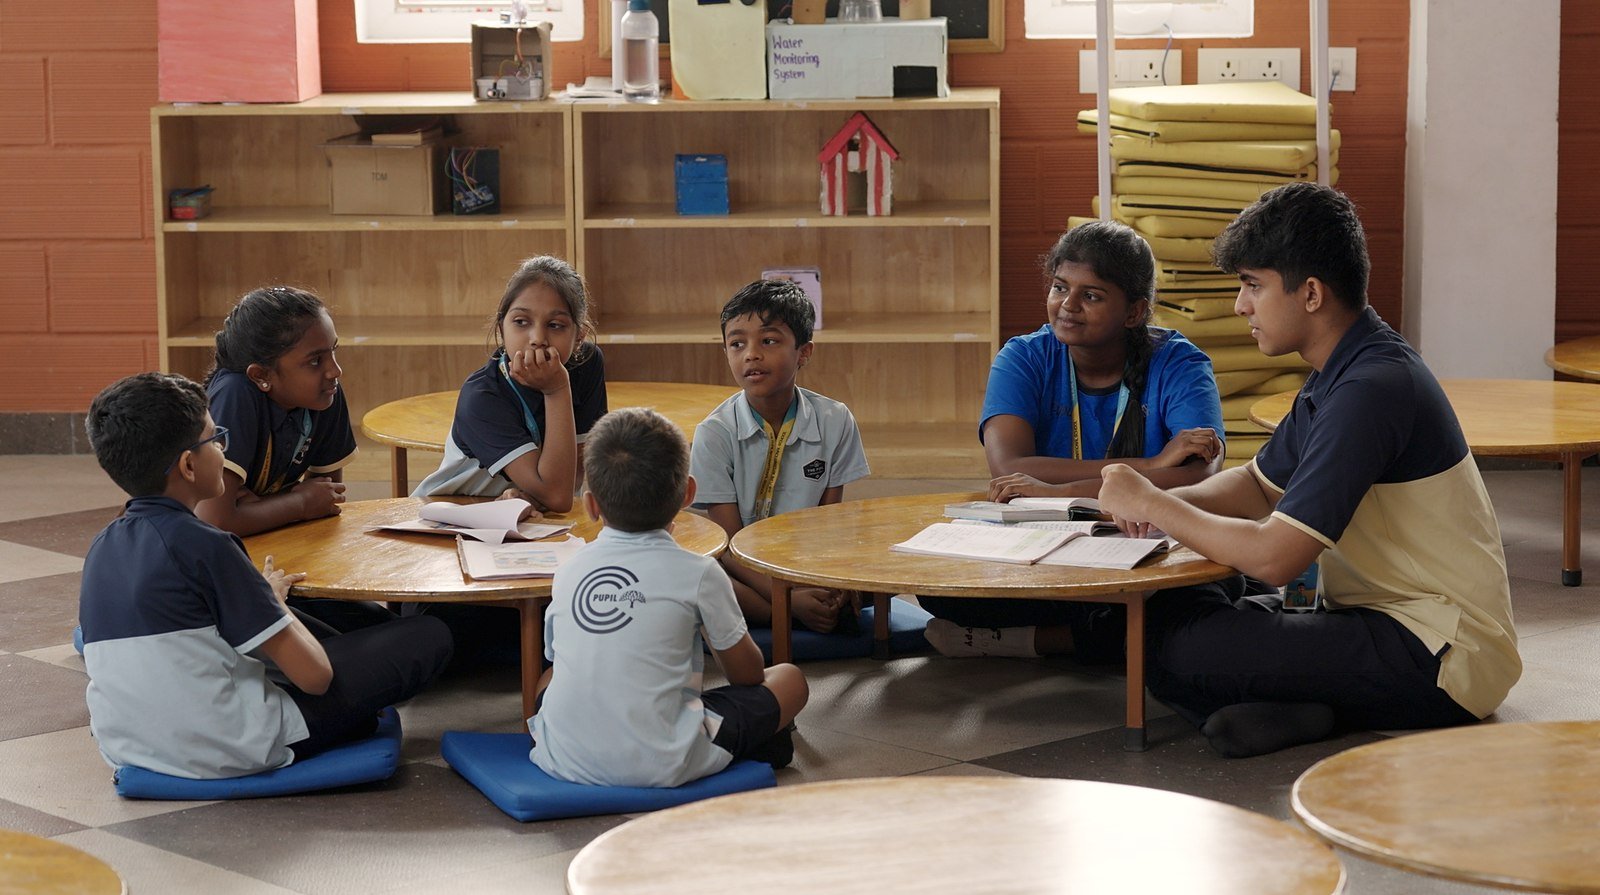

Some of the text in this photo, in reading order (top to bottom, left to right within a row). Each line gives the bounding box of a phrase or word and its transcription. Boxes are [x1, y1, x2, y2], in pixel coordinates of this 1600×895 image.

[772, 35, 803, 49] Water
[773, 52, 820, 68] Monitoring
[773, 69, 805, 83] System
[593, 594, 617, 602] PUPIL
[964, 626, 973, 647] PPY
